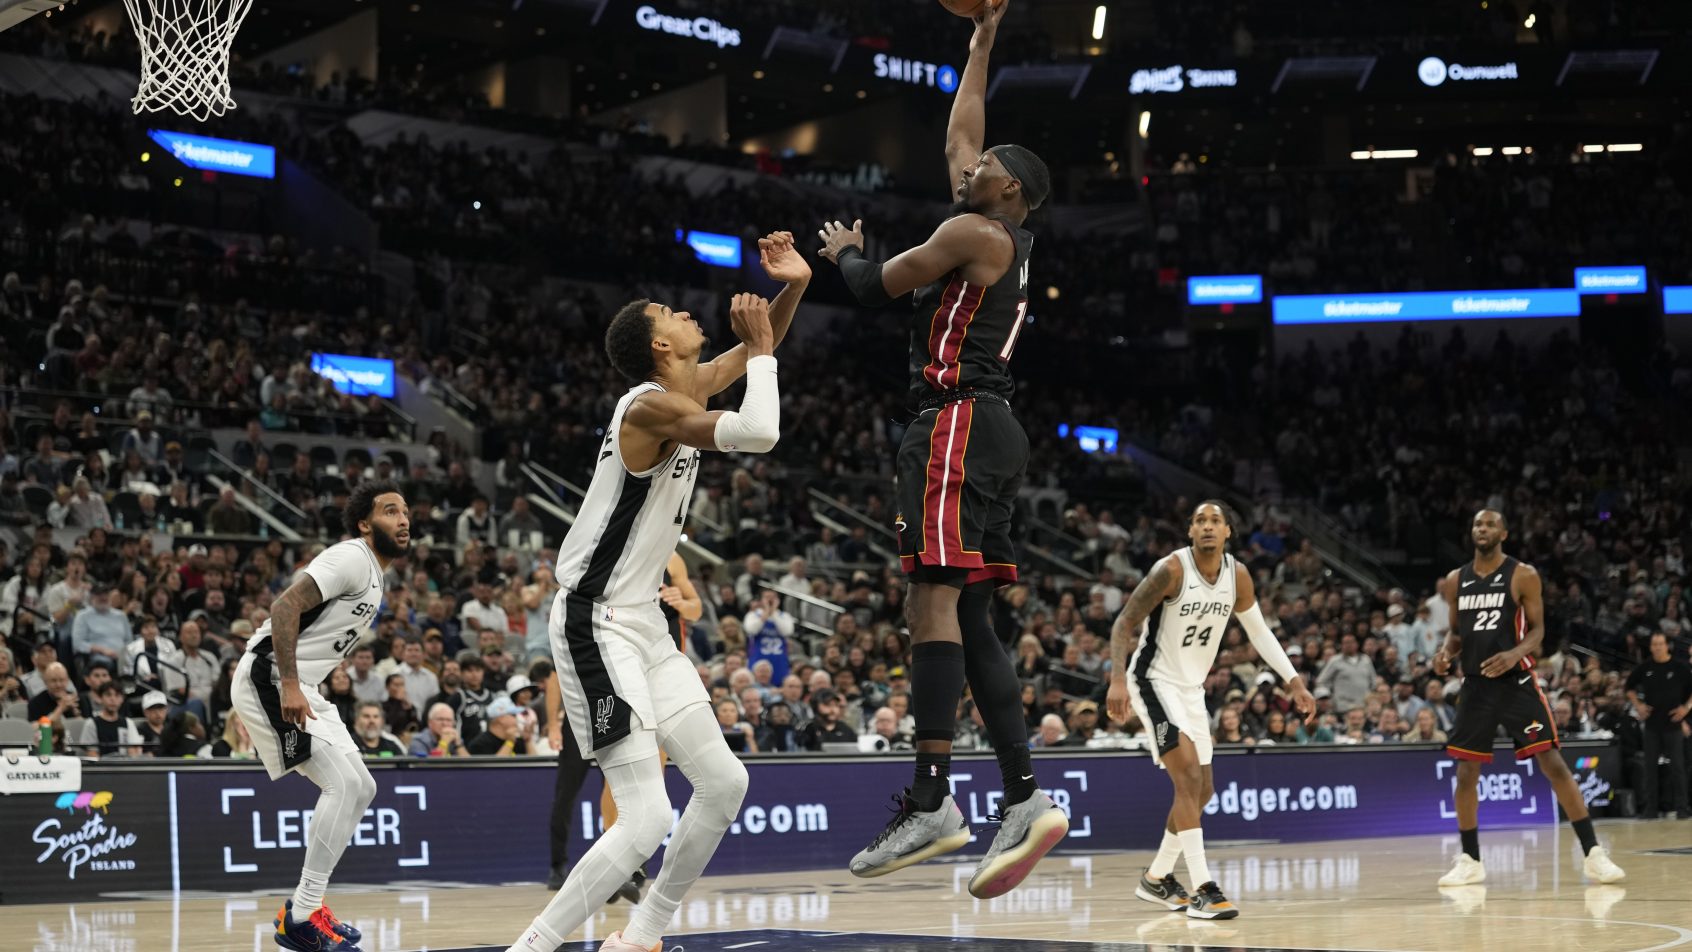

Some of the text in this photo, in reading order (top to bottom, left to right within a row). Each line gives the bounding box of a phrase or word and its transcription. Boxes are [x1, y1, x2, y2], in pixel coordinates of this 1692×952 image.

[998, 301, 1028, 361] 1
[1179, 601, 1231, 620] SPURS
[1458, 592, 1506, 611] MIAMI
[1473, 609, 1502, 632] 22
[333, 628, 361, 659] 3
[1182, 625, 1213, 648] 24
[6, 771, 62, 781] GATORADE
[1452, 773, 1523, 802] DGER
[1203, 781, 1358, 821] edger.com
[32, 813, 107, 863] South
[252, 808, 400, 849] LEER
[62, 826, 137, 880] Padre
[90, 859, 136, 871] ISLAND
